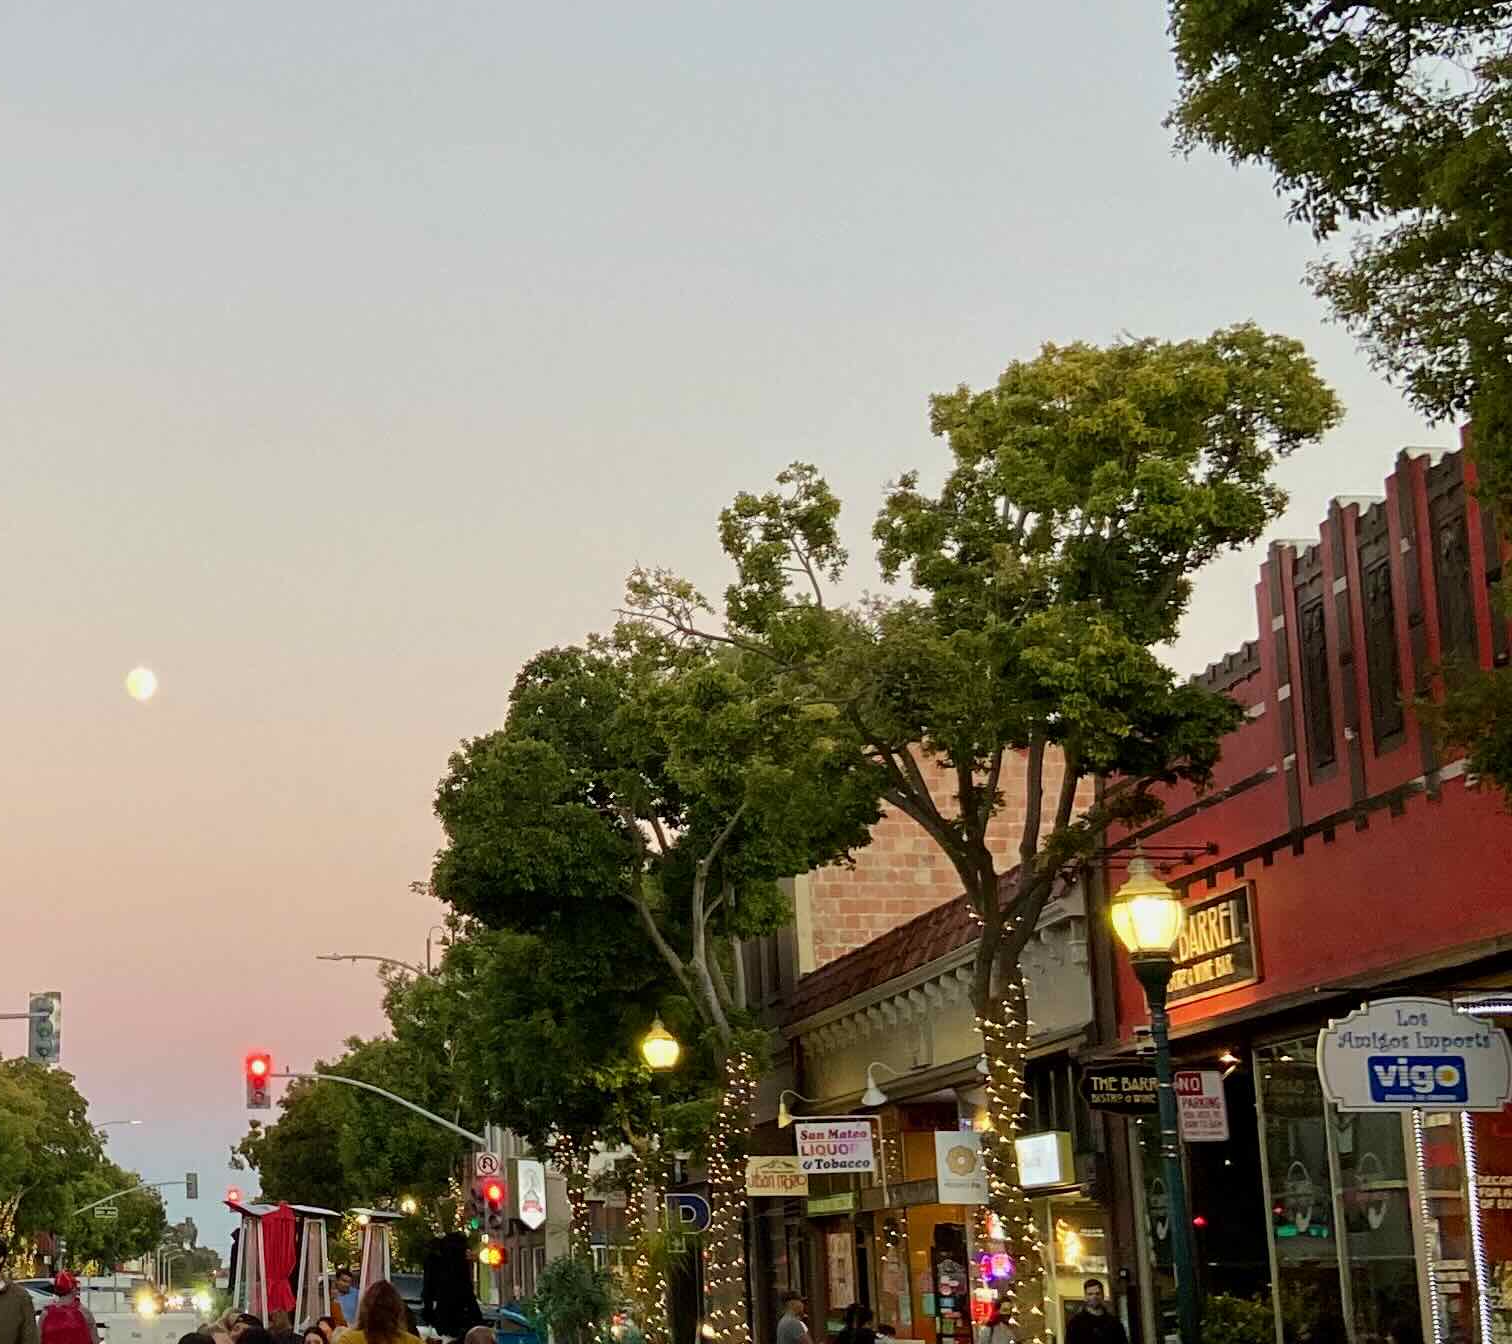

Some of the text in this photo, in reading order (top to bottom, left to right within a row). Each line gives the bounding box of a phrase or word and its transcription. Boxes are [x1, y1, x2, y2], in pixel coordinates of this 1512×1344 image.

[1396, 1009, 1428, 1027] Los
[1339, 1031, 1491, 1052] Amigos Imports
[1373, 1058, 1460, 1093] vigo
[1090, 1076, 1117, 1091] THE
[1178, 1077, 1200, 1091] NO
[1182, 1097, 1220, 1109] PARKING
[800, 1129, 868, 1140] San Mateo
[814, 1159, 871, 1169] Tobacco
